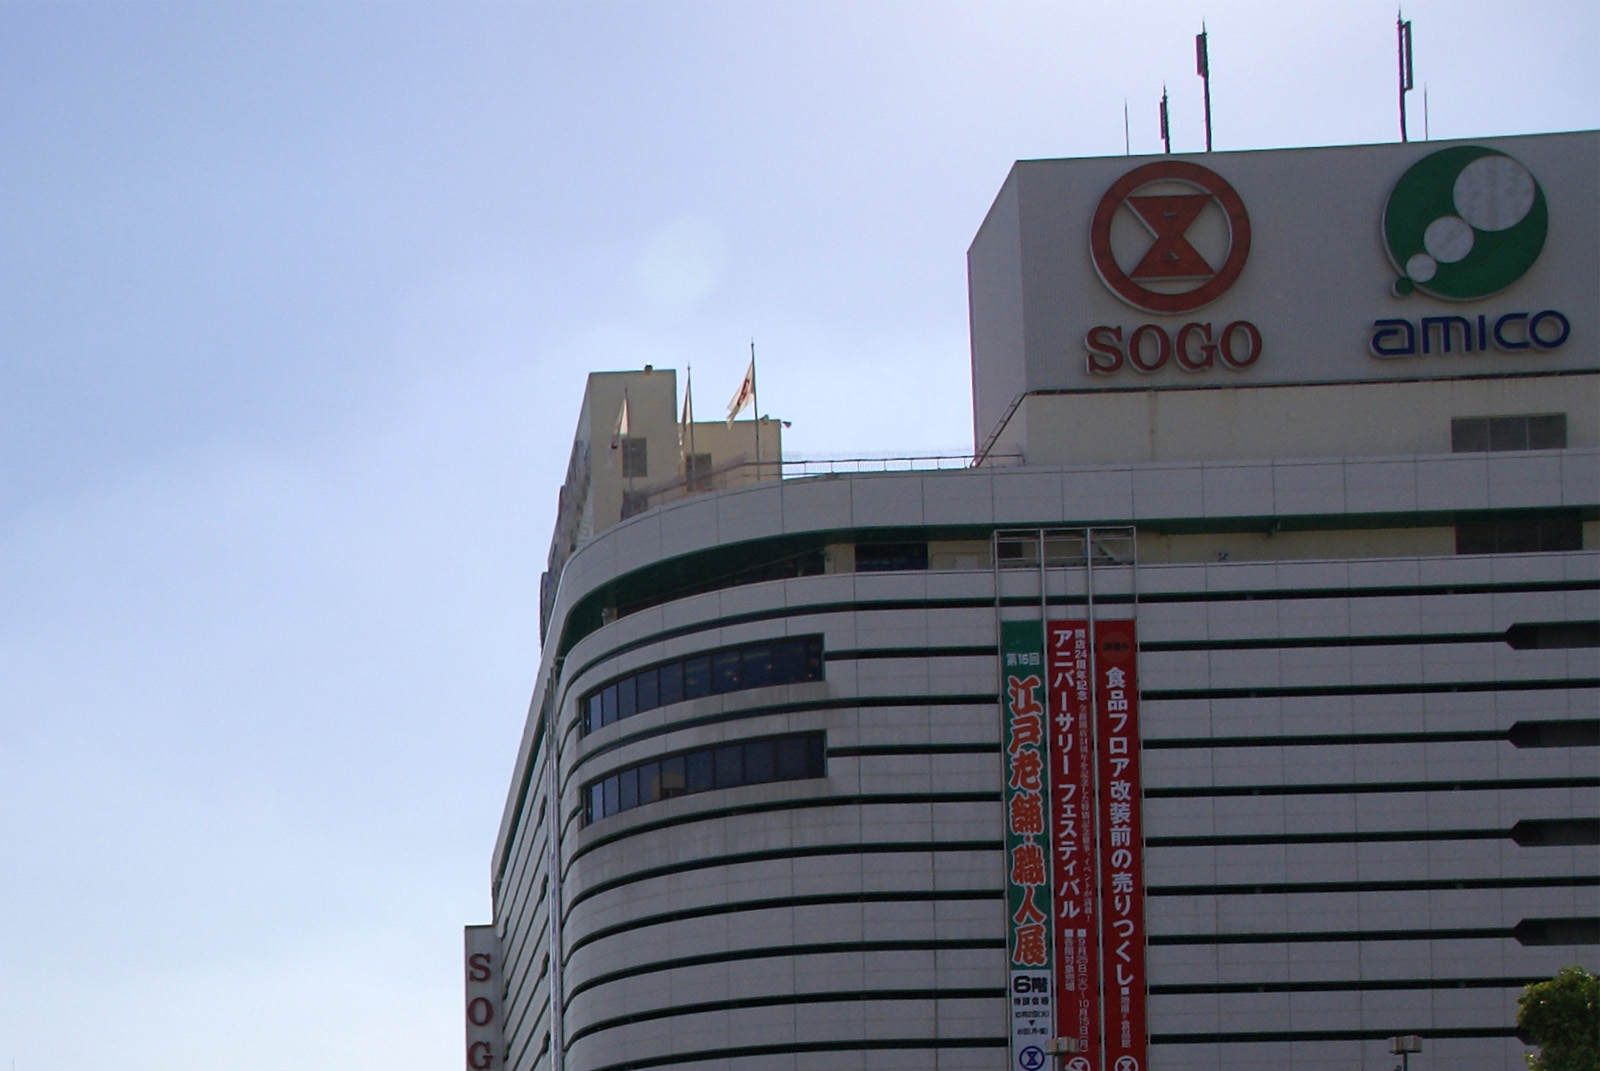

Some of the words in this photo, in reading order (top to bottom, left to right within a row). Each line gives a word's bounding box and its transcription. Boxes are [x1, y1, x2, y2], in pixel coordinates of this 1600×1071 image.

[1085, 320, 1263, 376] SOGO
[1370, 310, 1571, 358] amico
[1058, 783, 1081, 919] フェスティバル
[1013, 975, 1048, 994] 6階
